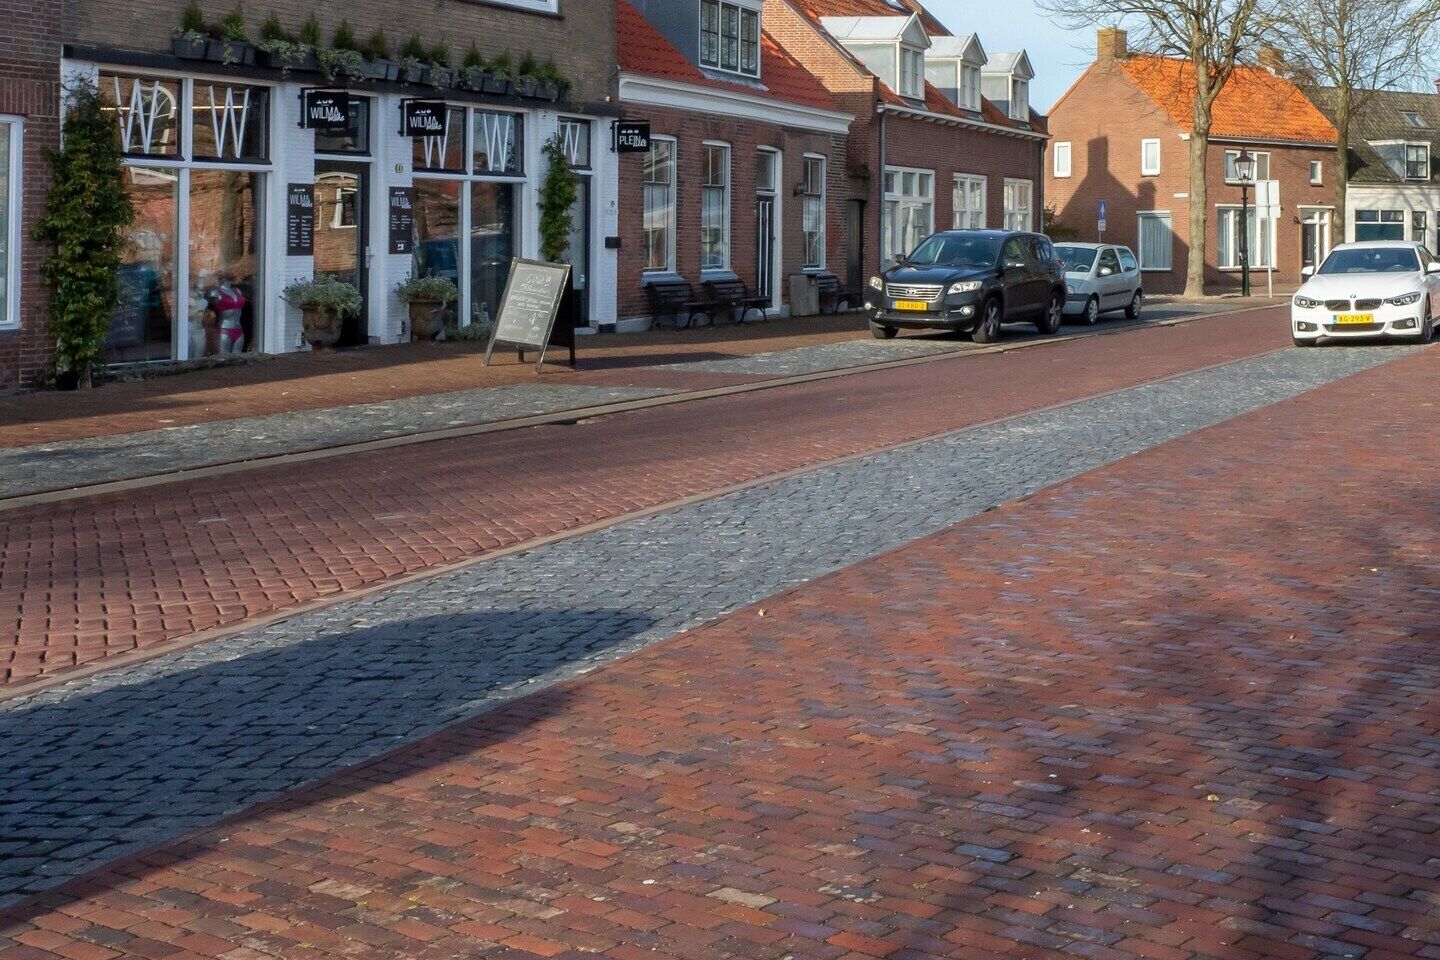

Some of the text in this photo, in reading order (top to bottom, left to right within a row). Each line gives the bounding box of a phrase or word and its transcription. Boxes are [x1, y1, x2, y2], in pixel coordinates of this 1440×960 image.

[114, 75, 250, 159] W W
[310, 106, 339, 119] WILMA
[409, 116, 436, 128] WILMA
[483, 112, 510, 173] W
[619, 135, 641, 145] PLEIN
[290, 194, 310, 205] WILMA
[391, 196, 409, 207] WILMA
